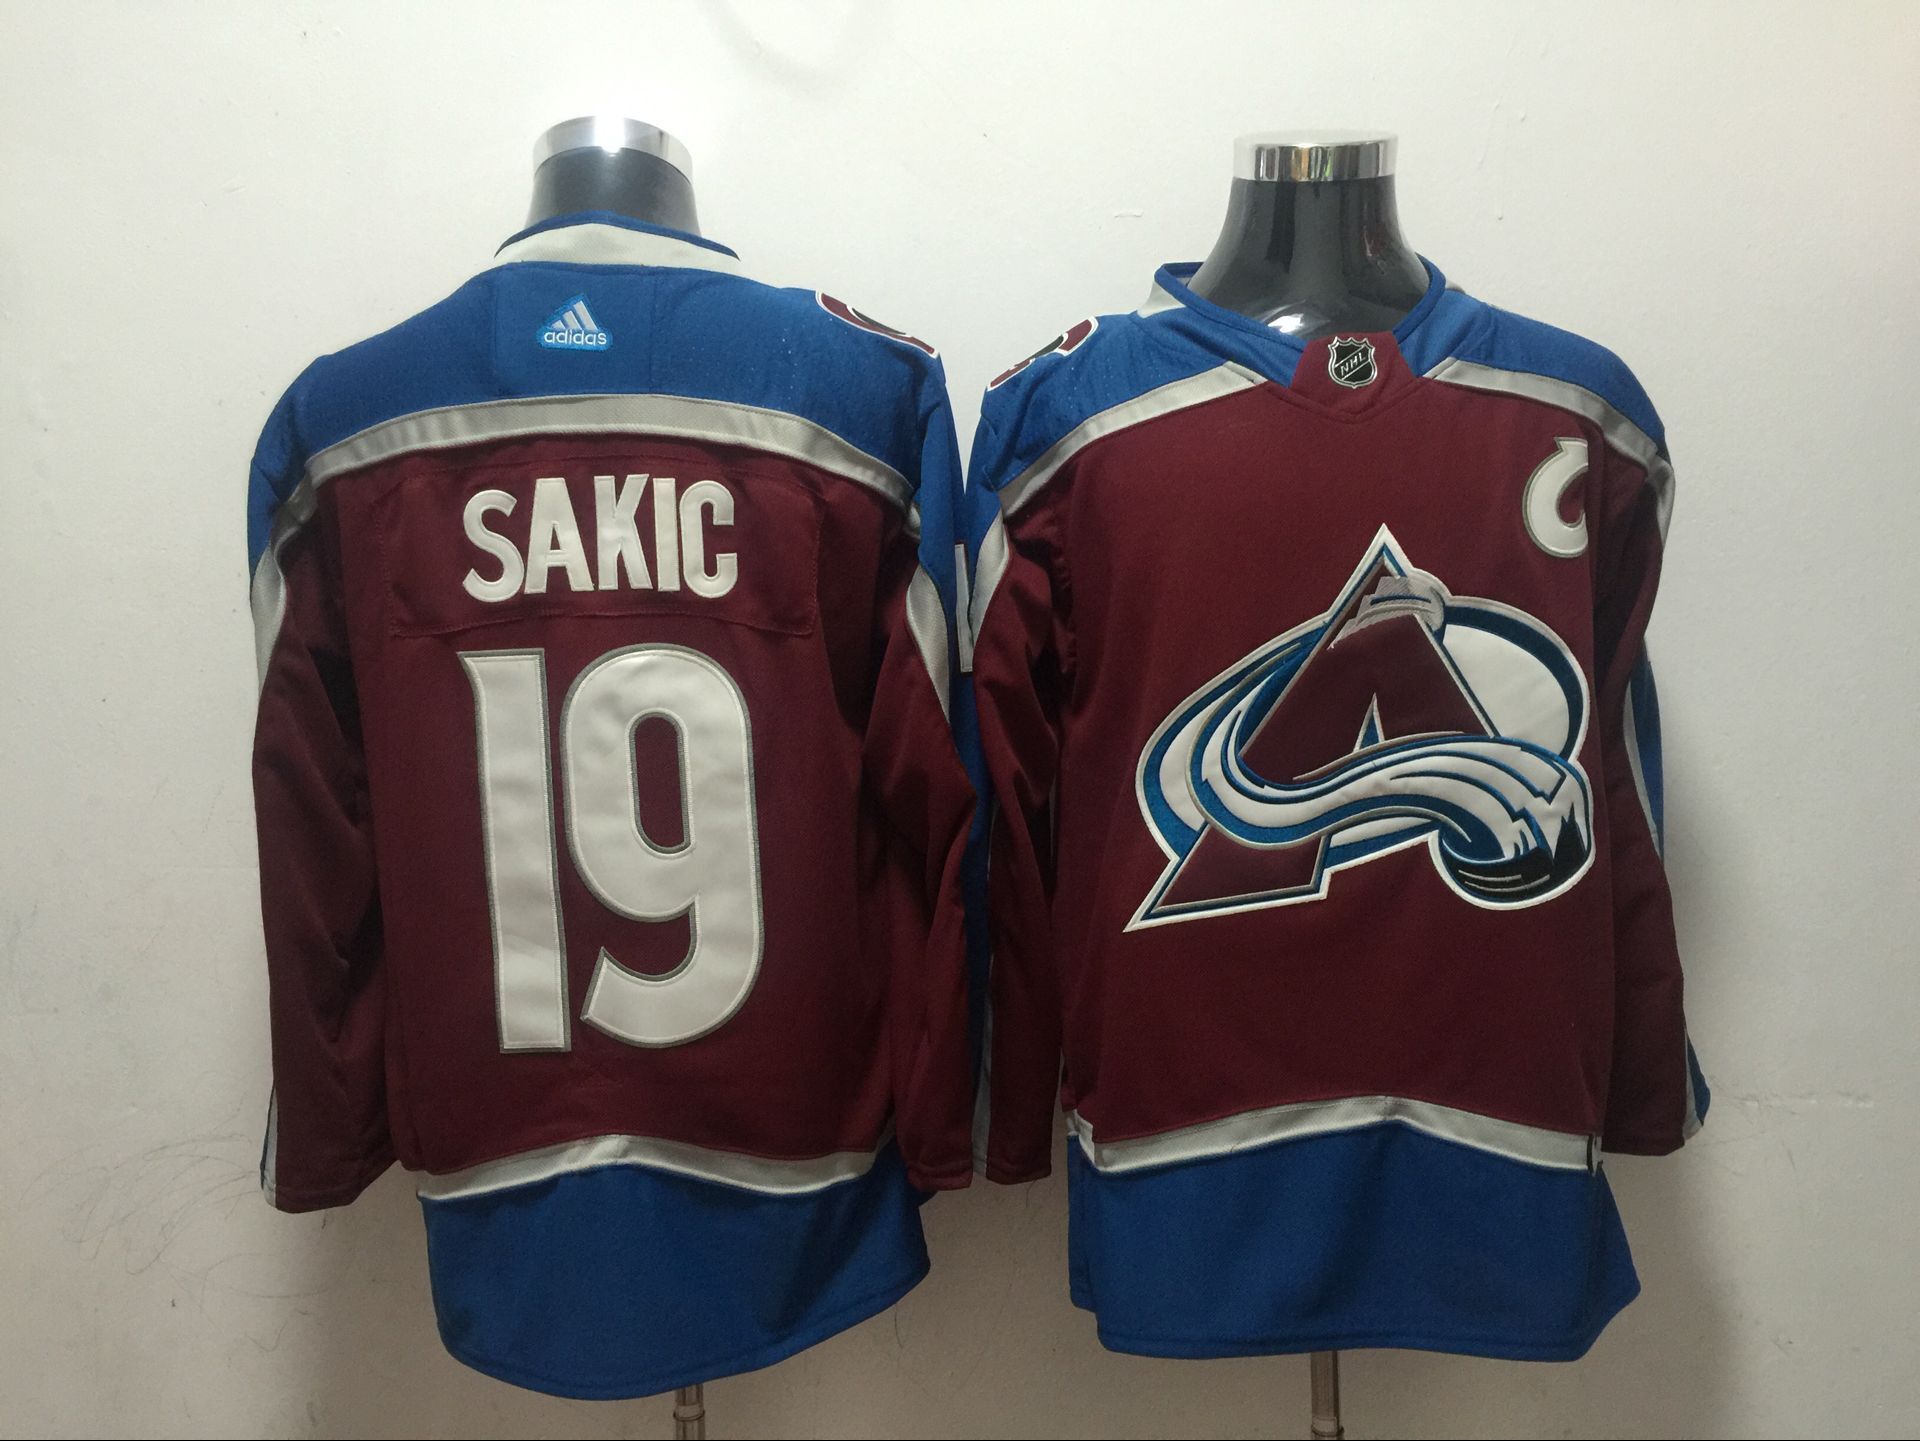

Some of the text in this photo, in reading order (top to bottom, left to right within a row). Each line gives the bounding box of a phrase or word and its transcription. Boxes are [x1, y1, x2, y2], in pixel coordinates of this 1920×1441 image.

[543, 329, 607, 345] adidas
[1340, 352, 1366, 376] NHL
[462, 473, 738, 603] SAKIC
[456, 643, 764, 1053] 19
